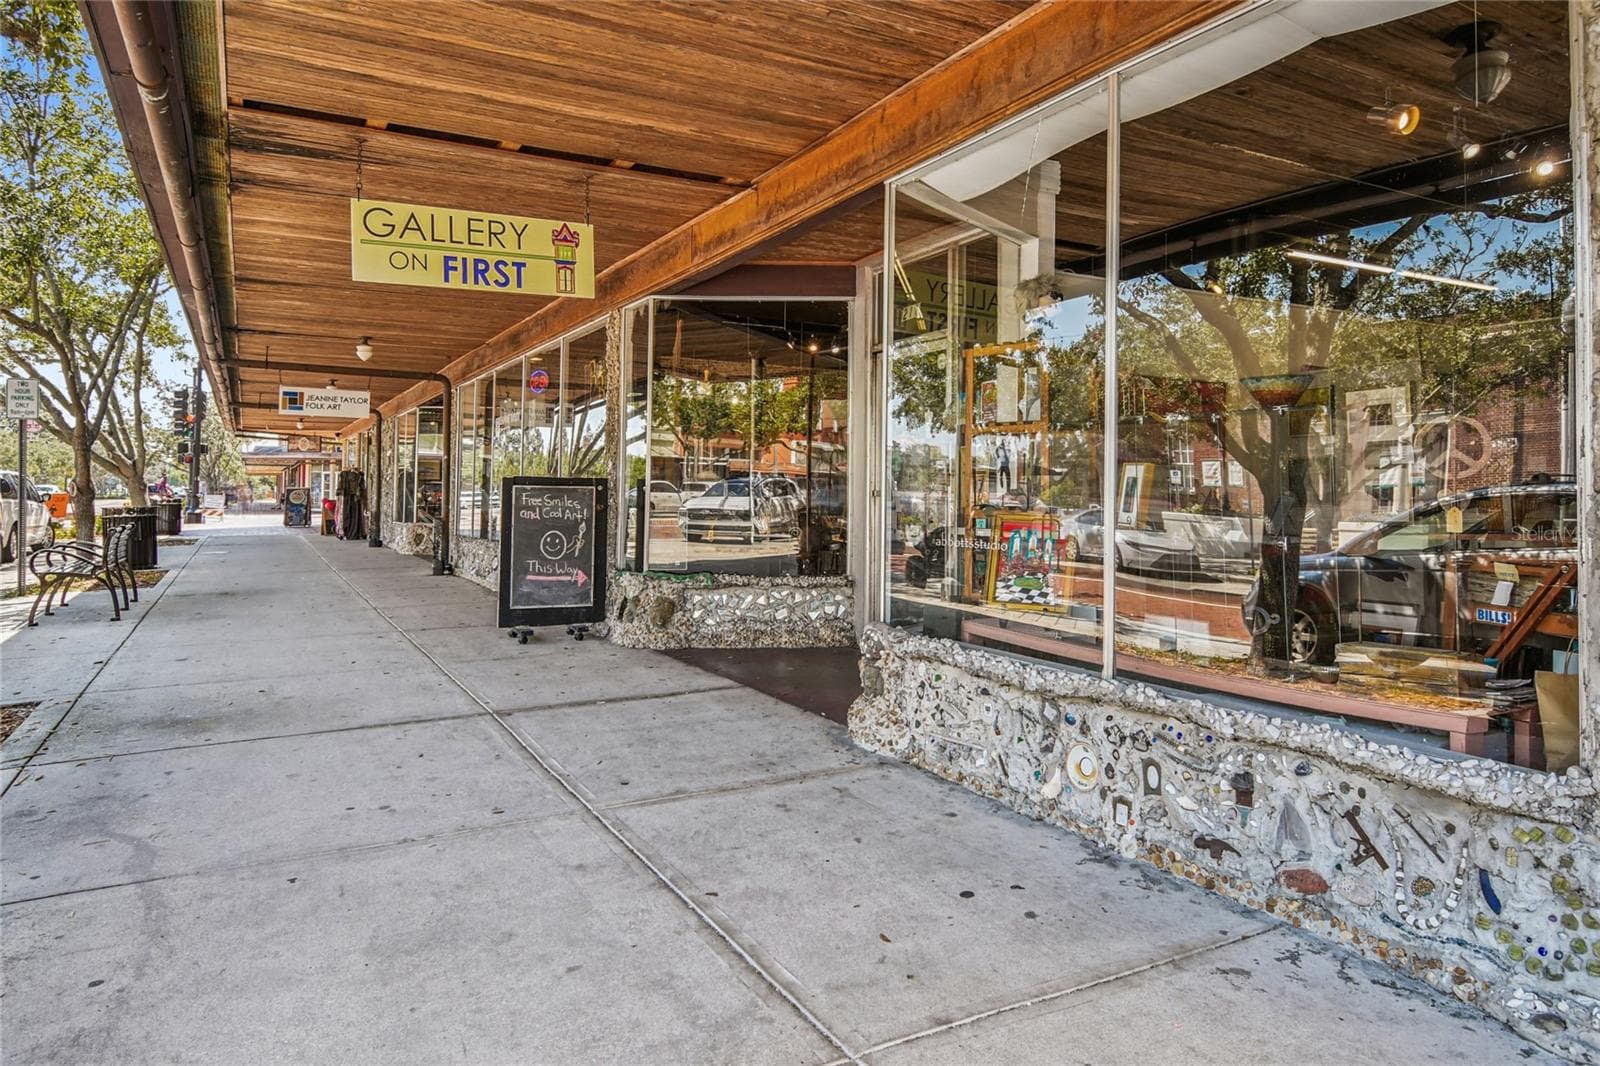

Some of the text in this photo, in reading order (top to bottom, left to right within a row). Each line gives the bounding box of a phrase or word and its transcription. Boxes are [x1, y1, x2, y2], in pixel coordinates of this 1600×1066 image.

[362, 207, 529, 250] GALLERY
[388, 250, 527, 289] ON FIRST
[305, 402, 341, 411] FOLK ART
[306, 394, 369, 405] JEANINE TAYLOR
[521, 492, 581, 509] Free Smiles
[519, 507, 587, 522] and Cool Art!
[525, 559, 579, 582] This Way
